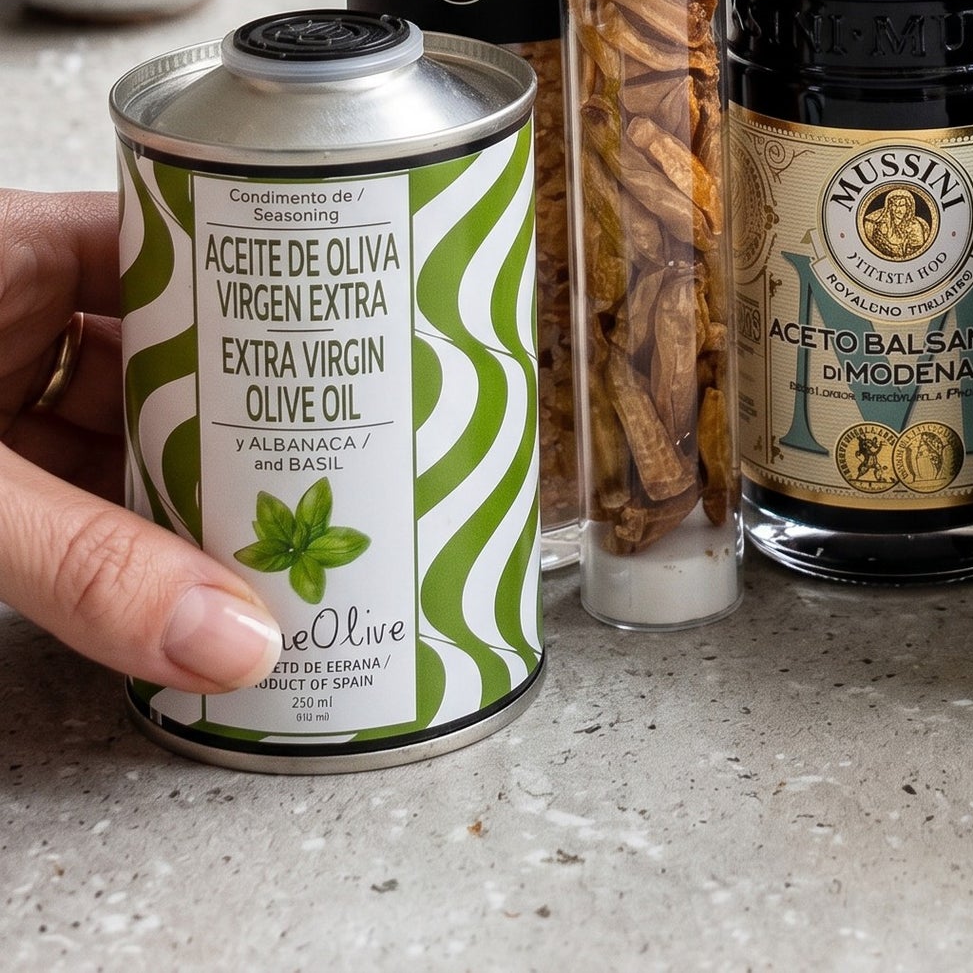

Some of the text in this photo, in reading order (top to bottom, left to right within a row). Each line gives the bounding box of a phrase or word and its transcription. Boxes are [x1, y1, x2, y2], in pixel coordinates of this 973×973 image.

[829, 152, 966, 212] MUSSINI
[229, 188, 328, 205] Condimento
[332, 188, 353, 203] de
[253, 207, 340, 224] Seasoning
[205, 232, 401, 277] ACEITE DE OLIVA
[216, 279, 388, 322] VIRGEN EXTRA
[769, 318, 858, 353] ACETO
[222, 335, 385, 378] EXTRA VIRGIN
[823, 364, 842, 381] DI
[246, 383, 361, 423] OLIVE OIL
[248, 435, 357, 452] ALBANACA
[254, 456, 344, 471] and BASIL
[304, 661, 322, 674] DE
[254, 674, 374, 691] ODUCT OF SPAIN
[292, 695, 333, 708] 250 ml
